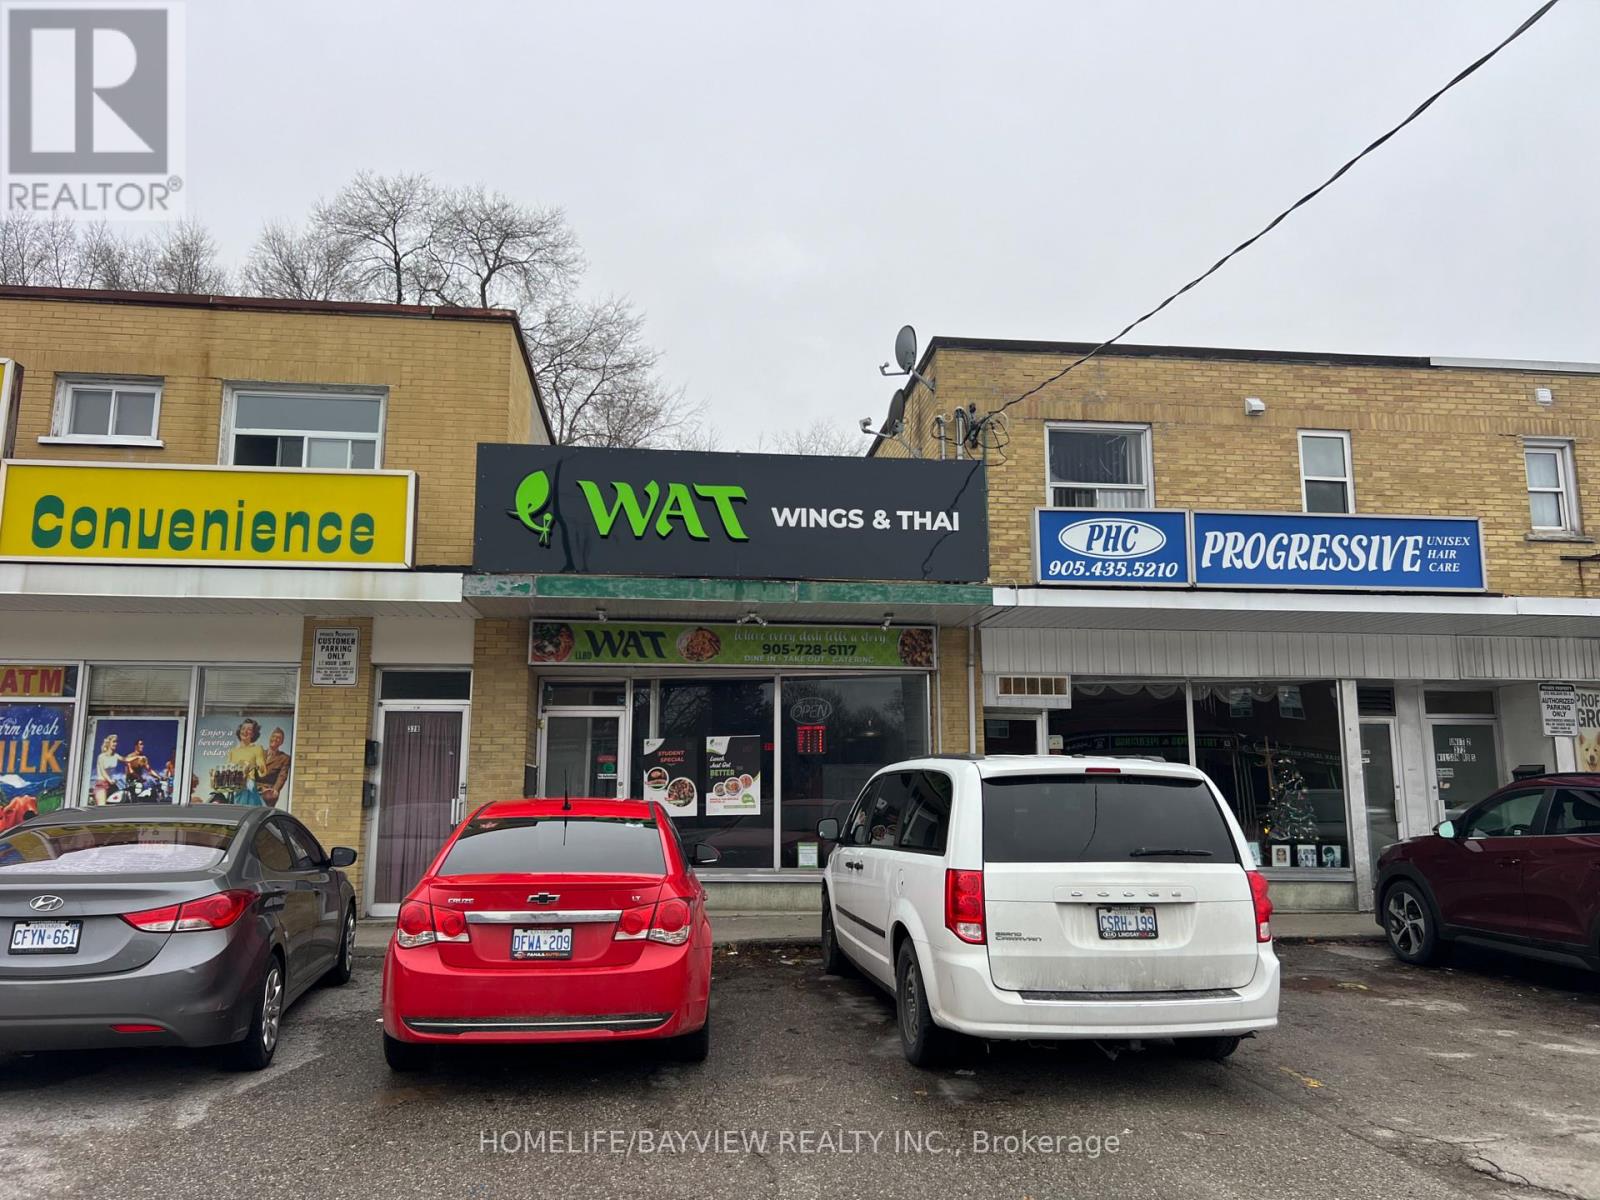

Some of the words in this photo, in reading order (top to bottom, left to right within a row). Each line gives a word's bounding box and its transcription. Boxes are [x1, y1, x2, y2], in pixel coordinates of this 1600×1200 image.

[576, 480, 751, 541] WAT
[771, 507, 864, 529] WINGS
[872, 509, 891, 530] &
[896, 510, 960, 531] THAI
[1086, 524, 1139, 553] PHC
[1426, 536, 1471, 546] UNISEX
[1201, 530, 1423, 572] PROGRESSIVE
[1427, 549, 1457, 559] HAIR
[1048, 560, 1178, 578] 905.435.5210
[1428, 562, 1461, 572] CARE
[318, 637, 356, 645] CUSTOMER
[584, 629, 667, 658] WAT
[327, 652, 346, 660] ONLY
[762, 643, 857, 656] 905-728-6117
[0, 669, 62, 693] ATM
[793, 703, 828, 719] OPEN
[22, 717, 60, 739] fresh
[1135, 915, 1155, 931] 199
[13, 929, 46, 945] CFYN
[52, 928, 77, 945] 661
[513, 935, 541, 950] DFWA
[549, 935, 570, 950] 209
